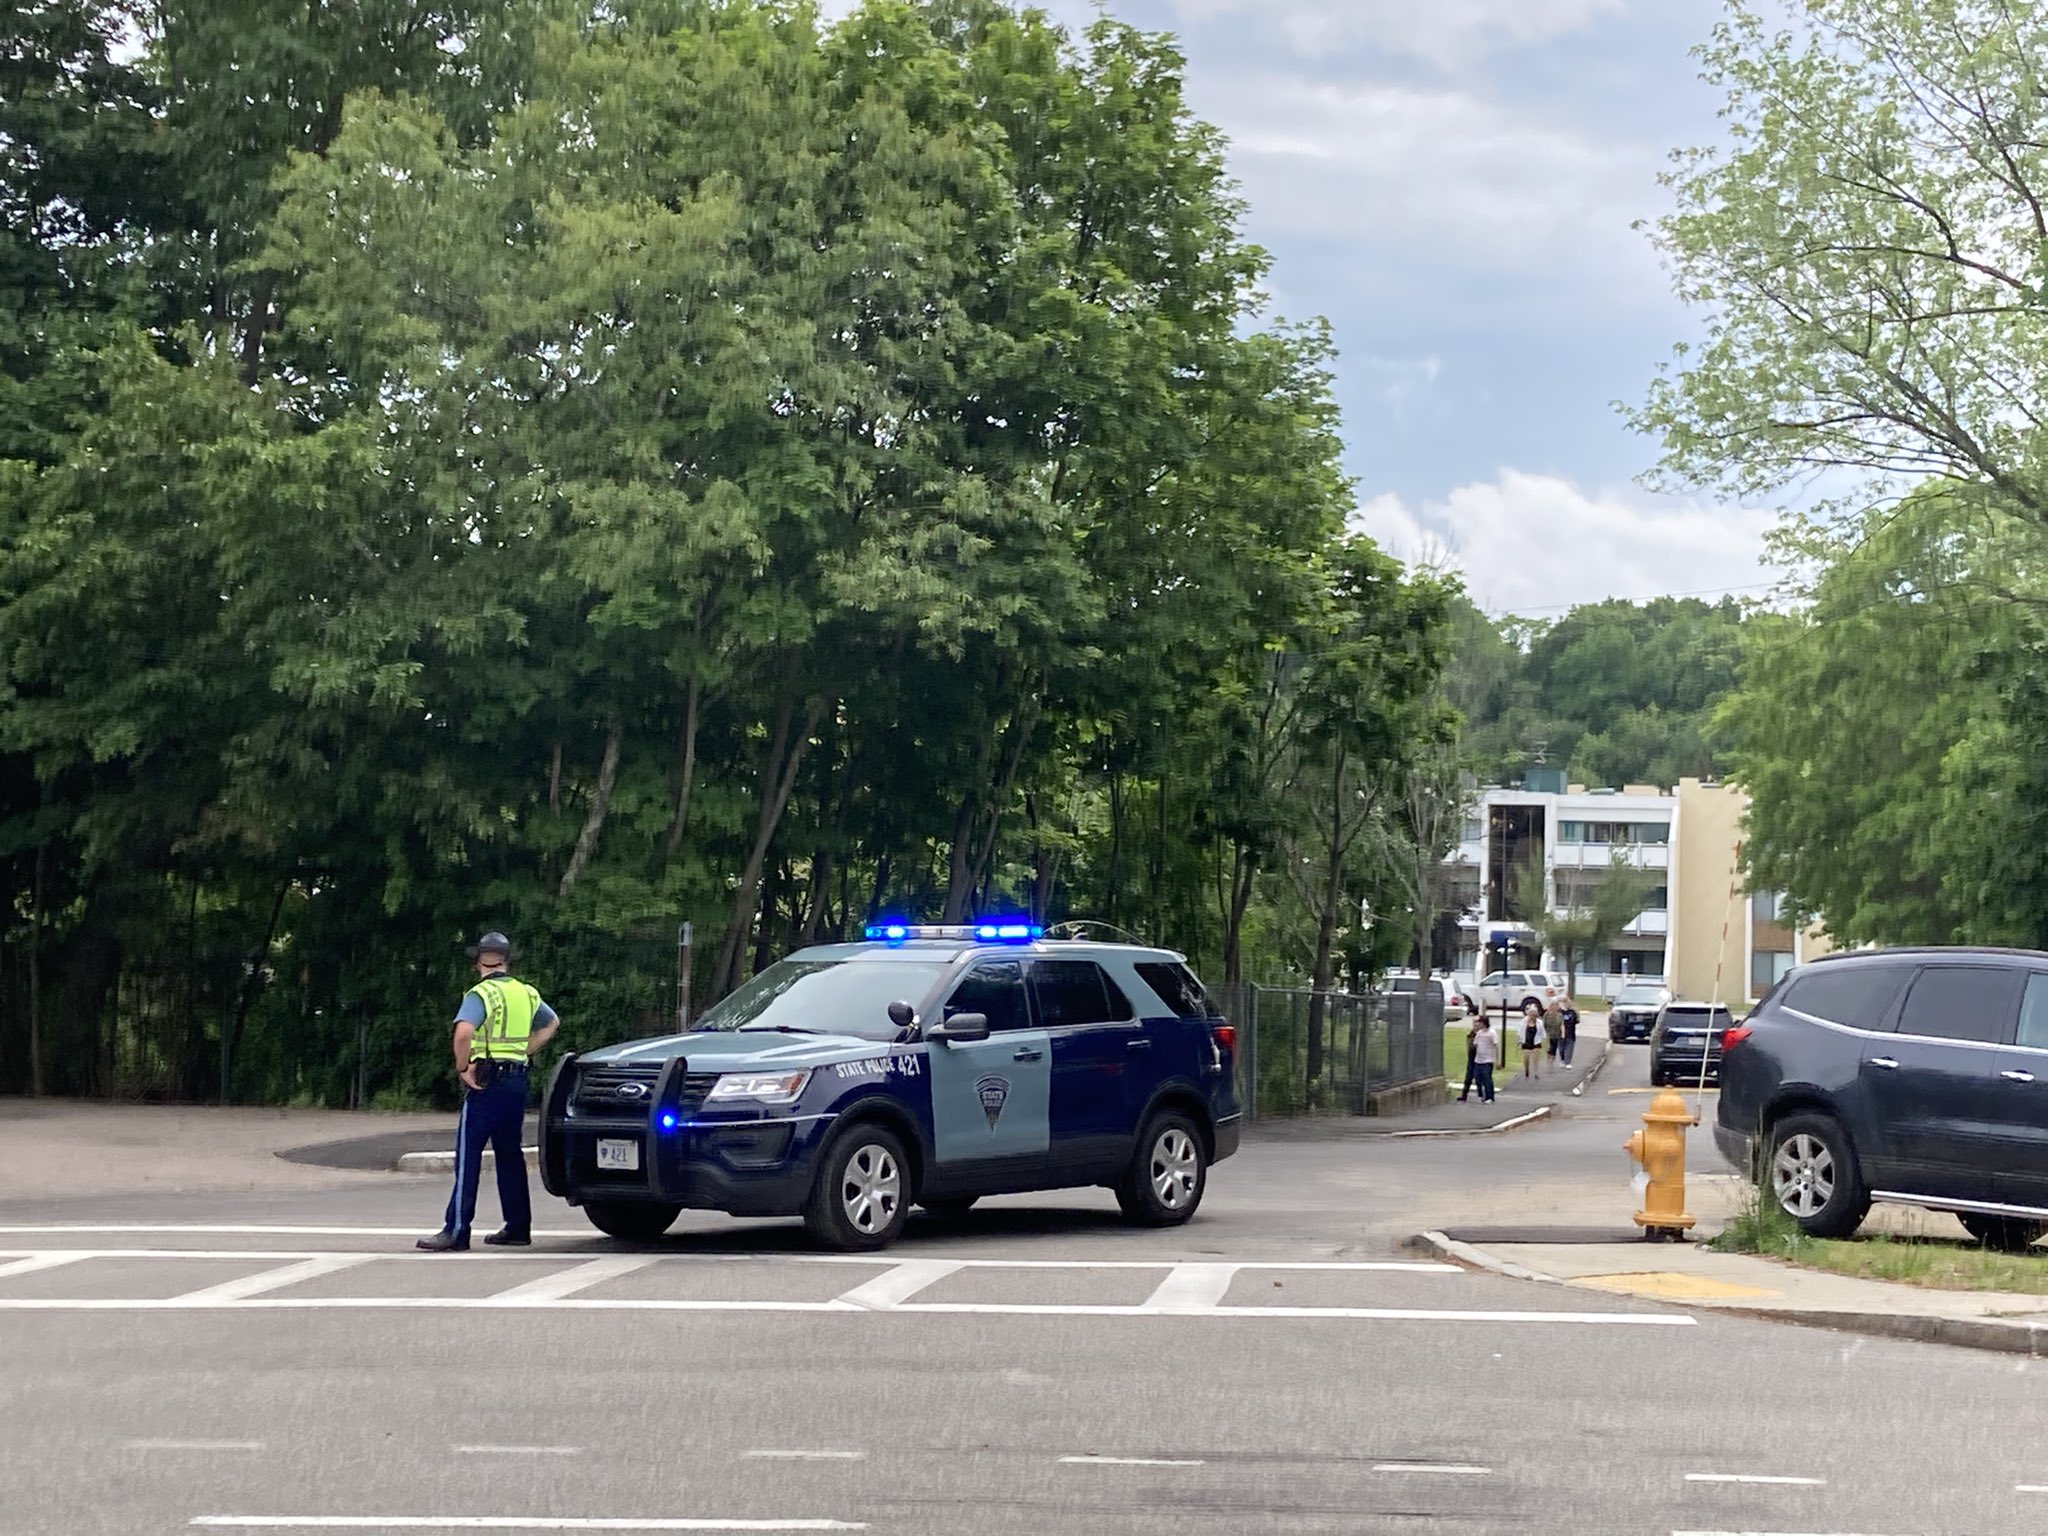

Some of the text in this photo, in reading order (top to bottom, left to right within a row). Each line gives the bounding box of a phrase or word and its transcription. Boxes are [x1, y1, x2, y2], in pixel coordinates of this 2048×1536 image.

[836, 1054, 921, 1078] STATE POLICE 421
[611, 1147, 627, 1162] 421
